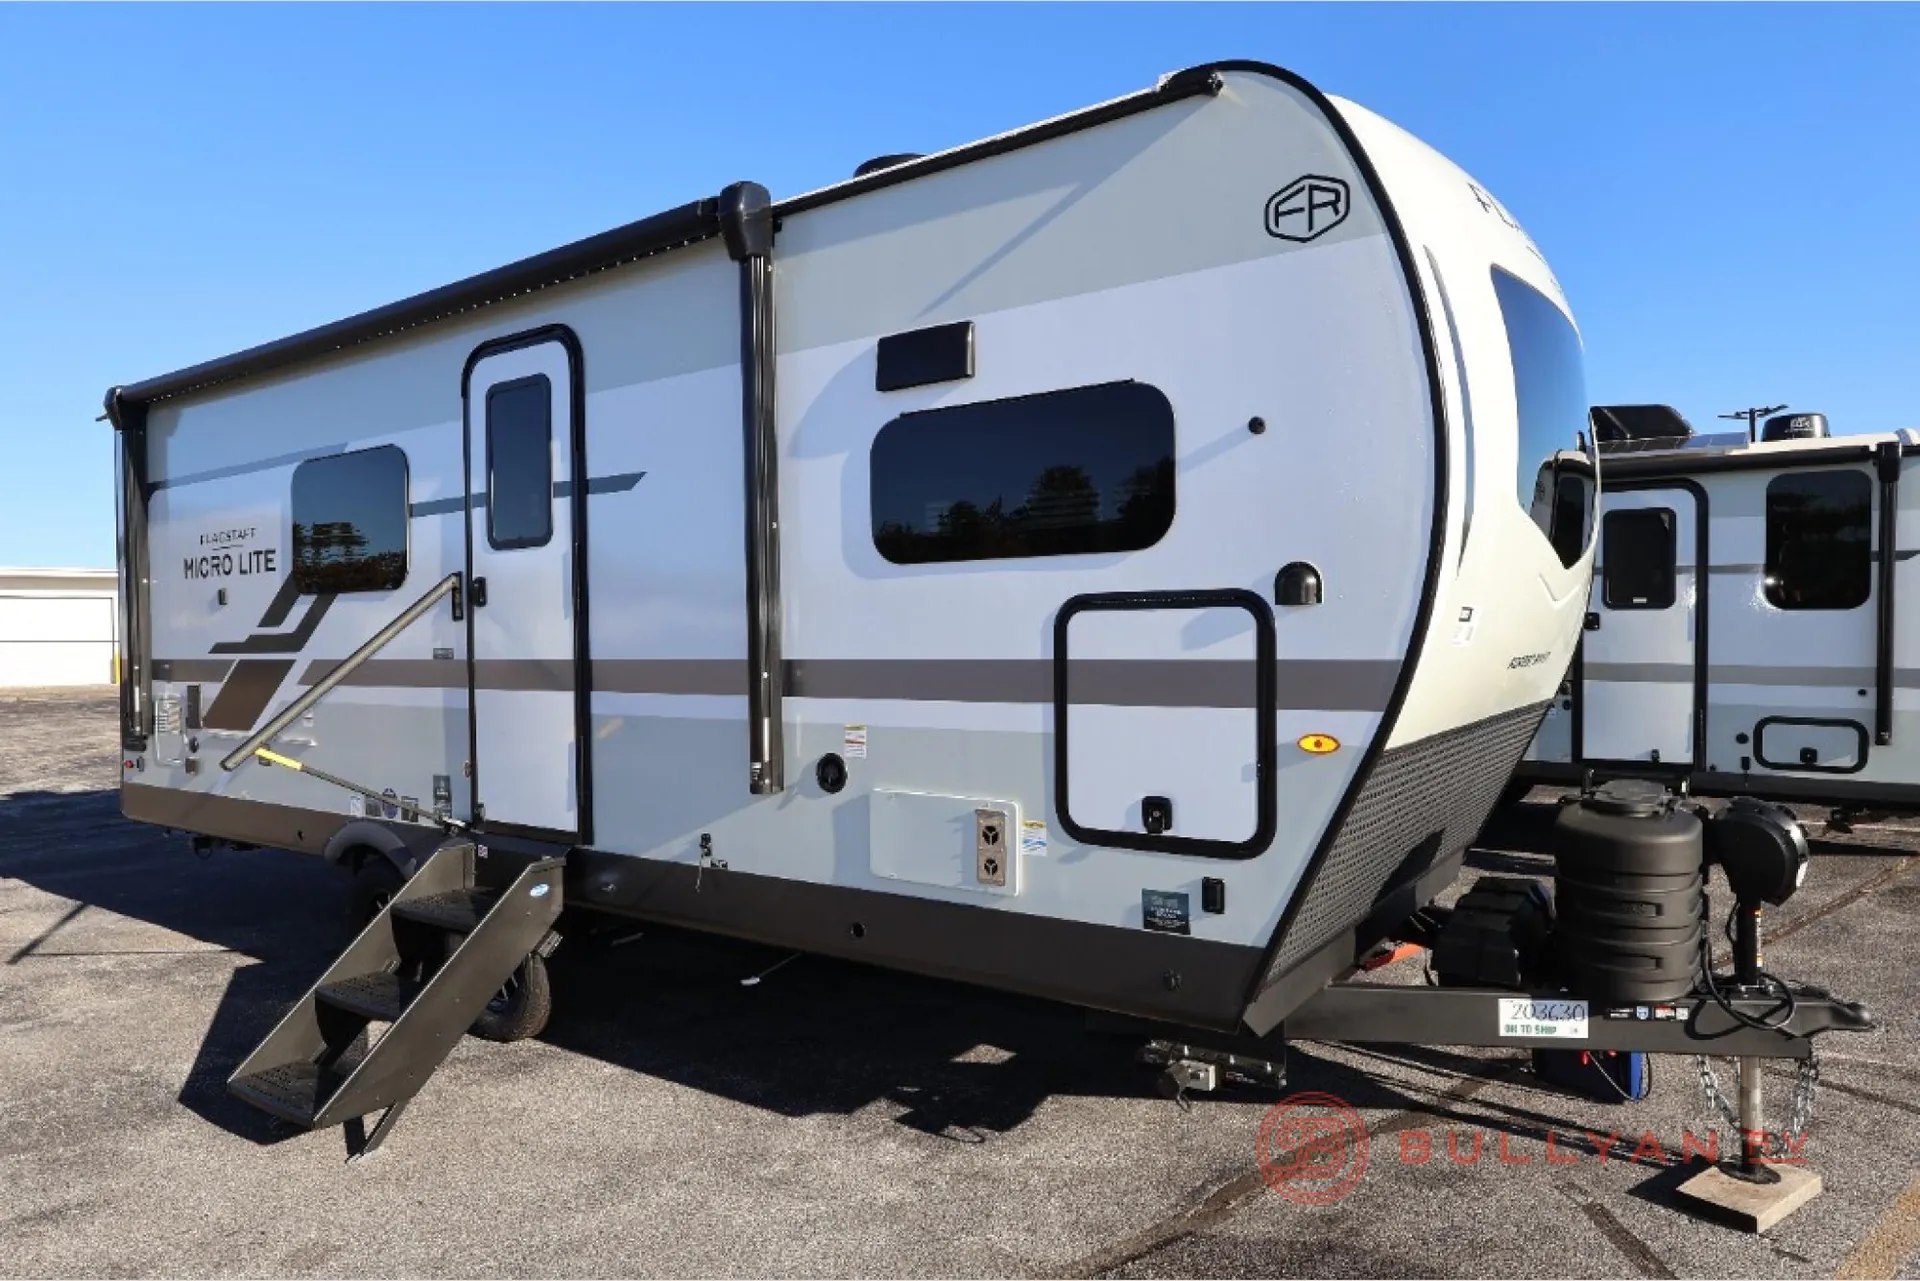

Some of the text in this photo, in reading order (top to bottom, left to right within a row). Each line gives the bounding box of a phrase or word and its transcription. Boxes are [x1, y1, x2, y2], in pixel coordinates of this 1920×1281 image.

[1273, 182, 1342, 233] FR
[183, 548, 277, 580] MICRO LITE
